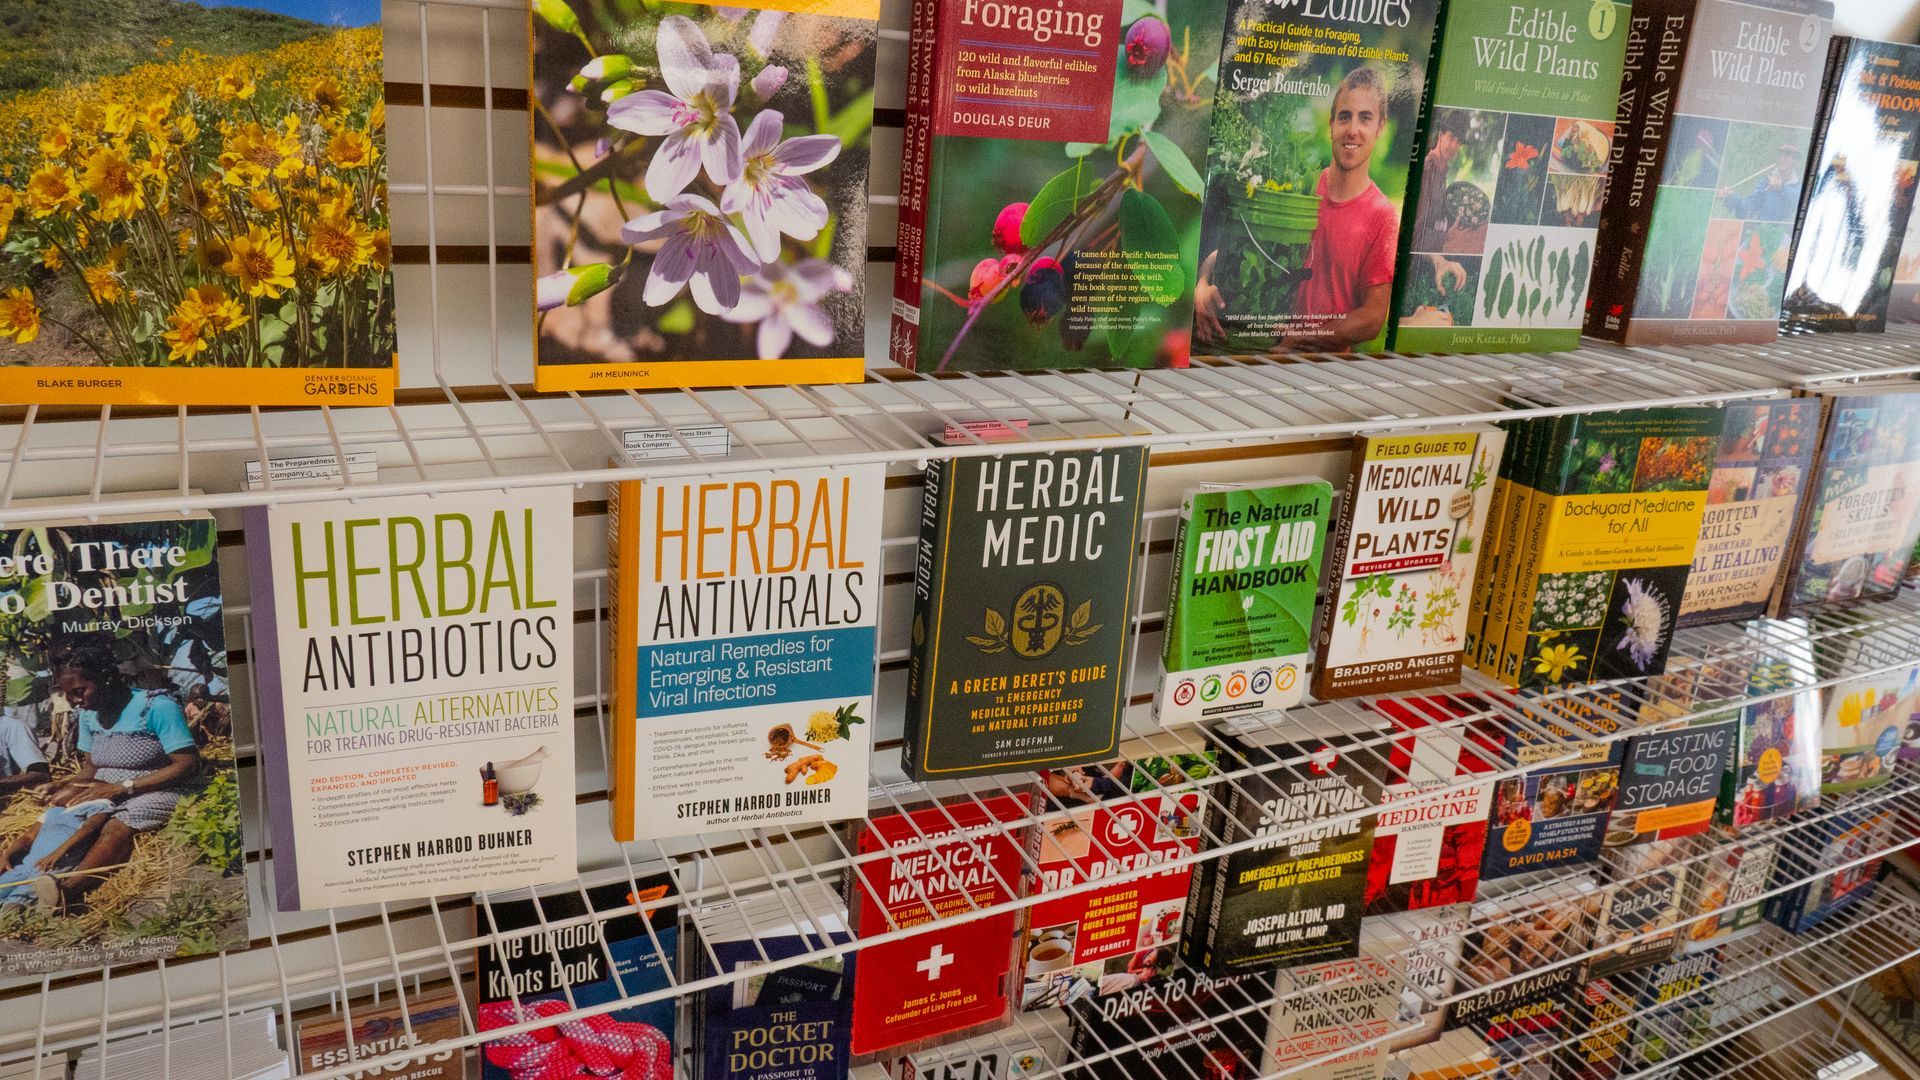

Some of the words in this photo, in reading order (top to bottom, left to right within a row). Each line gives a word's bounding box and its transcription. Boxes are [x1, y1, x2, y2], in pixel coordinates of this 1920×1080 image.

[962, 0, 1104, 47] Foraging
[1239, 20, 1246, 30] A
[1247, 20, 1285, 35] Practical
[1288, 24, 1312, 37] Guide
[1315, 28, 1323, 38] to
[1325, 29, 1361, 44] Foraging,
[1506, 6, 1577, 44] Edible
[1598, 10, 1606, 33] 1
[1236, 36, 1256, 48] with
[1259, 38, 1279, 52] Easy
[1280, 40, 1335, 56] Identification
[1337, 45, 1346, 56] of
[1347, 45, 1357, 57] 60
[1358, 47, 1382, 60] Edible
[1384, 49, 1409, 62] Plants
[1735, 21, 1790, 57] Edible
[958, 51, 976, 62] 120
[979, 52, 1001, 65] wild
[1003, 55, 1021, 67] and
[1023, 56, 1062, 70] flavorful
[1064, 60, 1097, 73] edibles
[1234, 51, 1252, 62] and
[1253, 53, 1264, 63] 67
[1266, 54, 1298, 68] Recipes
[1473, 36, 1529, 72] Wild
[1535, 44, 1599, 80] Plants
[1711, 49, 1752, 82] Wild
[1756, 57, 1806, 91] Plants
[957, 66, 980, 78] from
[983, 68, 1016, 81] Alaska
[1018, 71, 1070, 85] blueberries
[1232, 69, 1271, 98] Sergei
[1274, 73, 1330, 97] Boutenko
[955, 83, 963, 93] to
[965, 83, 990, 95] wild
[992, 85, 1038, 98] hazelnuts
[953, 112, 1014, 127] DOUGLAS
[1018, 116, 1050, 129] DEUR
[1075, 261, 1101, 269] because
[1103, 261, 1110, 269] of
[1111, 261, 1122, 269] the
[1123, 262, 1148, 270] endless
[1150, 262, 1173, 272] bounty
[37, 380, 74, 388] BLAKE
[77, 379, 122, 388] BURGER
[589, 371, 603, 379] JIM
[606, 370, 650, 378] MEUNINCK
[304, 382, 378, 396] GARDENS
[641, 441, 672, 450] Company:
[1376, 443, 1410, 456] FIELD
[1414, 442, 1449, 455] GUIDE
[1454, 442, 1467, 452] TO
[976, 455, 1124, 512] HERBAL
[1366, 463, 1463, 492] MEDICINAL
[1205, 508, 1242, 528] The
[1246, 498, 1320, 524] Natural
[1378, 497, 1441, 524] WILD
[1565, 501, 1632, 518] Backyard
[1634, 498, 1696, 515] Medicine
[1847, 504, 1890, 525] SKILLS
[654, 477, 864, 583] HERBAL
[982, 511, 1106, 568] MEDIC
[1608, 519, 1627, 533] for
[1629, 518, 1649, 532] All
[1195, 525, 1271, 575] FIRST
[1271, 520, 1317, 565] AID
[1353, 528, 1450, 560] PLANTS
[1712, 545, 1779, 571] HEALING
[291, 508, 557, 629] HERBAL
[1360, 562, 1392, 572] REVISED
[1395, 560, 1401, 568] &
[1404, 556, 1439, 567] UPDATED
[1191, 564, 1309, 597] HANDBOOK
[1697, 581, 1760, 598] WARNOCK
[653, 571, 864, 641] ANTIVIRALS
[63, 618, 121, 634] Murray
[128, 615, 192, 630] Dickson
[303, 615, 557, 693] ANTIBIOTICS
[651, 645, 715, 668] Natural
[721, 638, 805, 660] Remedies
[809, 635, 834, 652] for
[651, 667, 732, 689] Emerging
[736, 662, 749, 679] &
[755, 656, 833, 678] Resistant
[950, 680, 958, 695] A
[964, 675, 1008, 695] GREEN
[1071, 664, 1108, 683] GUIDE
[1334, 661, 1403, 679] BRADFORD
[1407, 654, 1455, 670] ANGIER
[649, 688, 689, 709] Viral
[693, 683, 776, 704] Infections
[971, 707, 1011, 721] MEDICAL
[1014, 699, 1084, 716] PREPAREDNESS
[996, 696, 1004, 704] TO
[1007, 688, 1062, 703] EMERGENCY
[306, 703, 407, 737] NATURAL
[414, 687, 559, 726] ALTERNATIVES
[972, 724, 985, 733] AND
[988, 718, 1029, 732] NATURAL
[1032, 715, 1059, 727] FIRST
[1062, 713, 1077, 724] AID
[307, 739, 332, 755] FOR
[336, 729, 395, 751] TREATING
[399, 719, 500, 744] DRUG-RESISTANT
[505, 713, 559, 731] BACTERIA
[995, 739, 1013, 750] SAM
[1015, 735, 1054, 748] COFFMAN
[1635, 730, 1726, 760] FEASTING
[1667, 753, 1718, 776] FOOD
[1624, 773, 1714, 805] STORAGE
[1260, 786, 1365, 826] SURVIVAL
[1376, 799, 1479, 828] MEDICINE
[348, 842, 411, 867] STEPHEN
[417, 835, 472, 857] HARROD
[478, 829, 533, 850] BUHNER
[890, 842, 999, 881] MEDICAL
[1289, 841, 1321, 857] GUIDE
[1509, 851, 1544, 868] DAVID
[1546, 847, 1578, 861] NASH
[1239, 862, 1295, 884] EMERGENCY
[1296, 850, 1365, 872] PREPAREDNESS
[1258, 878, 1276, 892] FOR
[1277, 874, 1297, 888] ANY
[1298, 866, 1342, 884] DISASTER
[888, 865, 996, 905] MANUAL
[1243, 914, 1286, 936] JOSEPH
[1286, 908, 1324, 927] ALTON,
[1326, 903, 1345, 920] MD
[7, 947, 79, 960] Introduction
[83, 944, 98, 954] by
[102, 937, 134, 949] David
[139, 934, 178, 945] Werner
[489, 932, 523, 961] The
[531, 920, 607, 956] Outdoor
[1081, 946, 1098, 957] JEFF
[1099, 939, 1131, 953] GARRETT
[488, 960, 543, 999] Knots
[550, 956, 598, 986] Book
[903, 996, 928, 1009] James
[930, 994, 938, 1003] C.
[939, 987, 962, 1001] Jones
[1456, 991, 1506, 1018] BREAD
[1509, 967, 1572, 997] MAKING
[770, 1011, 797, 1023] THE
[733, 1021, 834, 1050] POCKET
[729, 1043, 834, 1072] DOCTOR
